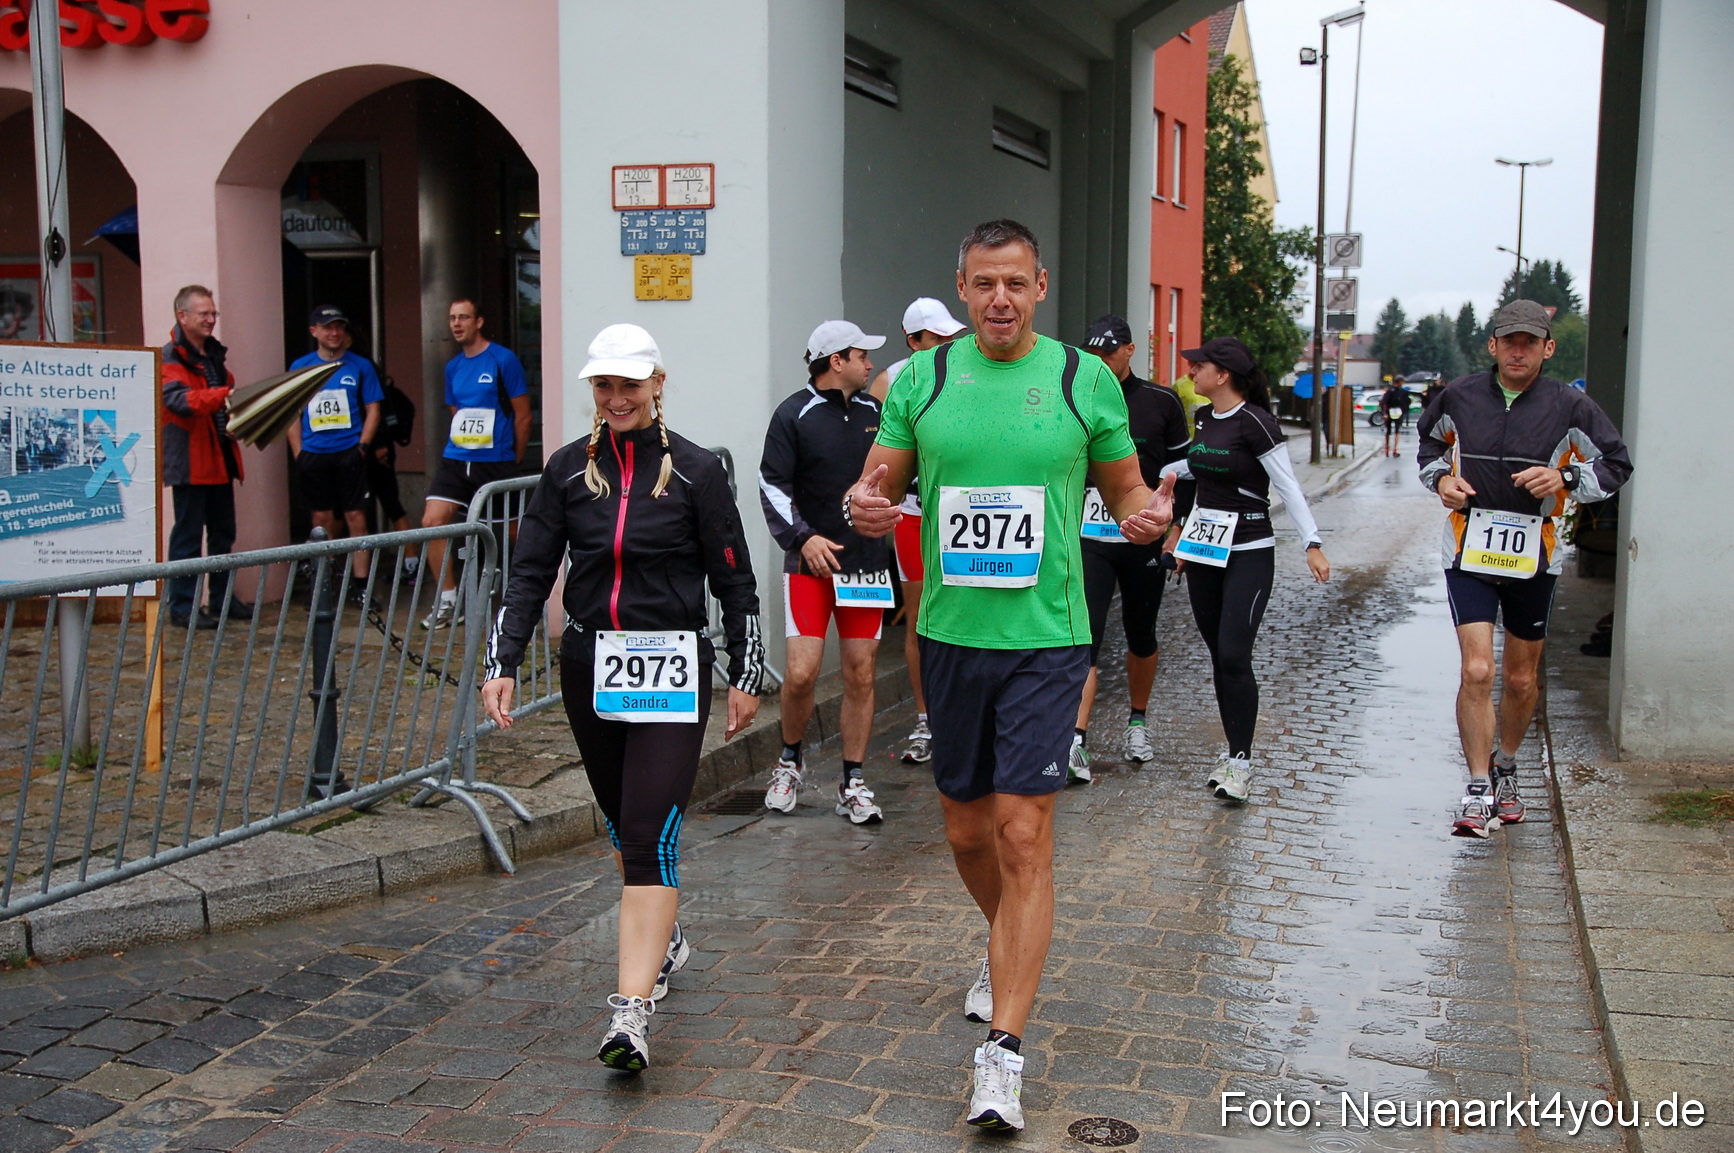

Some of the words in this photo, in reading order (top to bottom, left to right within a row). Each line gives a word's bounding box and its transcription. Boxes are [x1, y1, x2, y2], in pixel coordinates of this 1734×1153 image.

[22, 360, 94, 378] Altstadt
[100, 363, 137, 378] darf
[40, 384, 116, 400] sterben!
[316, 400, 340, 415] 484
[460, 420, 484, 434] 475
[15, 492, 40, 503] zum
[969, 493, 1011, 503] BOCK
[8, 520, 25, 530] 18.
[28, 511, 87, 528] September
[90, 504, 121, 518] 2011!
[950, 514, 1034, 549] 2974
[1187, 521, 1229, 544] 2647
[1483, 527, 1526, 553] 110
[969, 558, 1012, 575] Jürgen
[1481, 554, 1518, 568] Christof
[851, 590, 879, 599] Markus
[605, 655, 688, 688] 2973
[622, 696, 668, 709] Sandra
